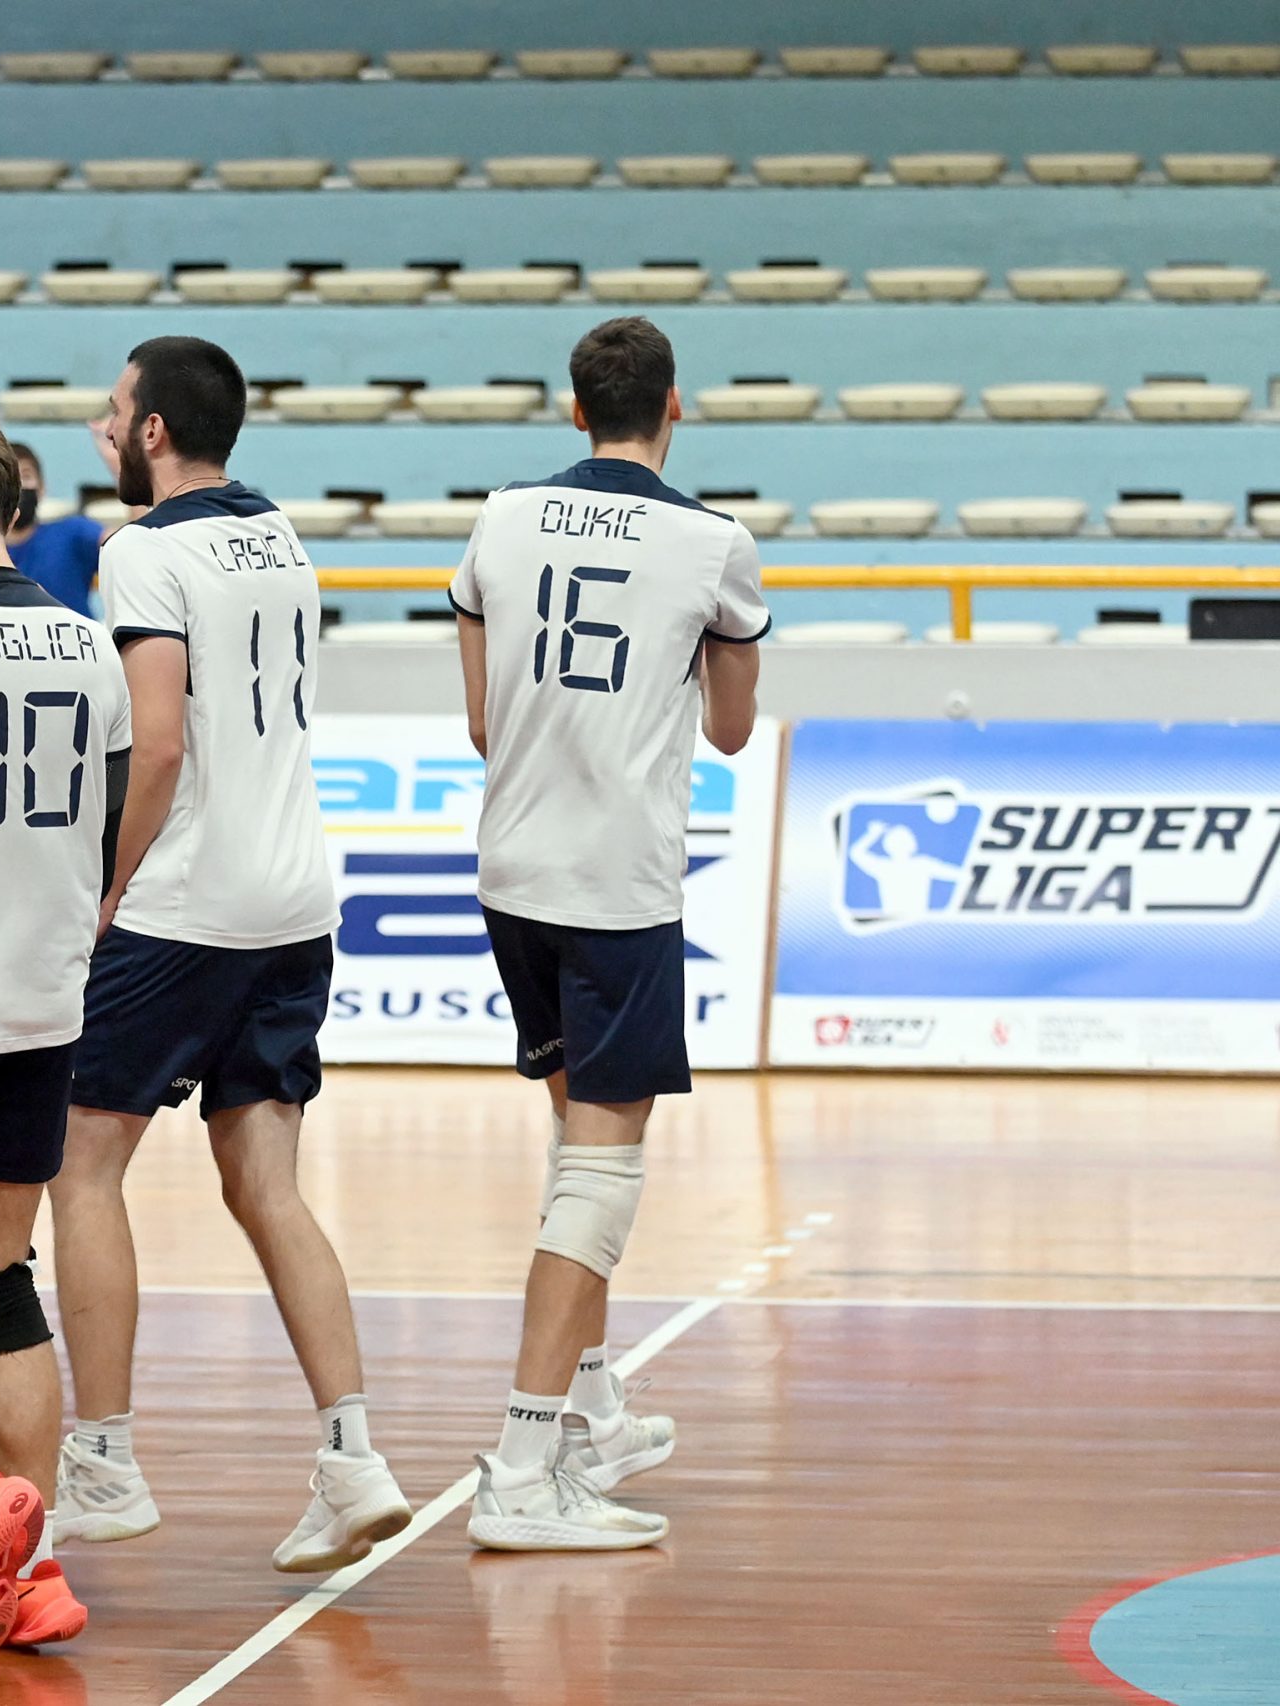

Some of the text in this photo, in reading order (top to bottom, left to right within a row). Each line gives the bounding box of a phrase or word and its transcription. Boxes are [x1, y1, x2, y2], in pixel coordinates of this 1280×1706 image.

[250, 607, 307, 738] 11
[533, 563, 632, 693] 16
[979, 806, 1252, 852] SUPER
[960, 864, 1133, 912] LIGA
